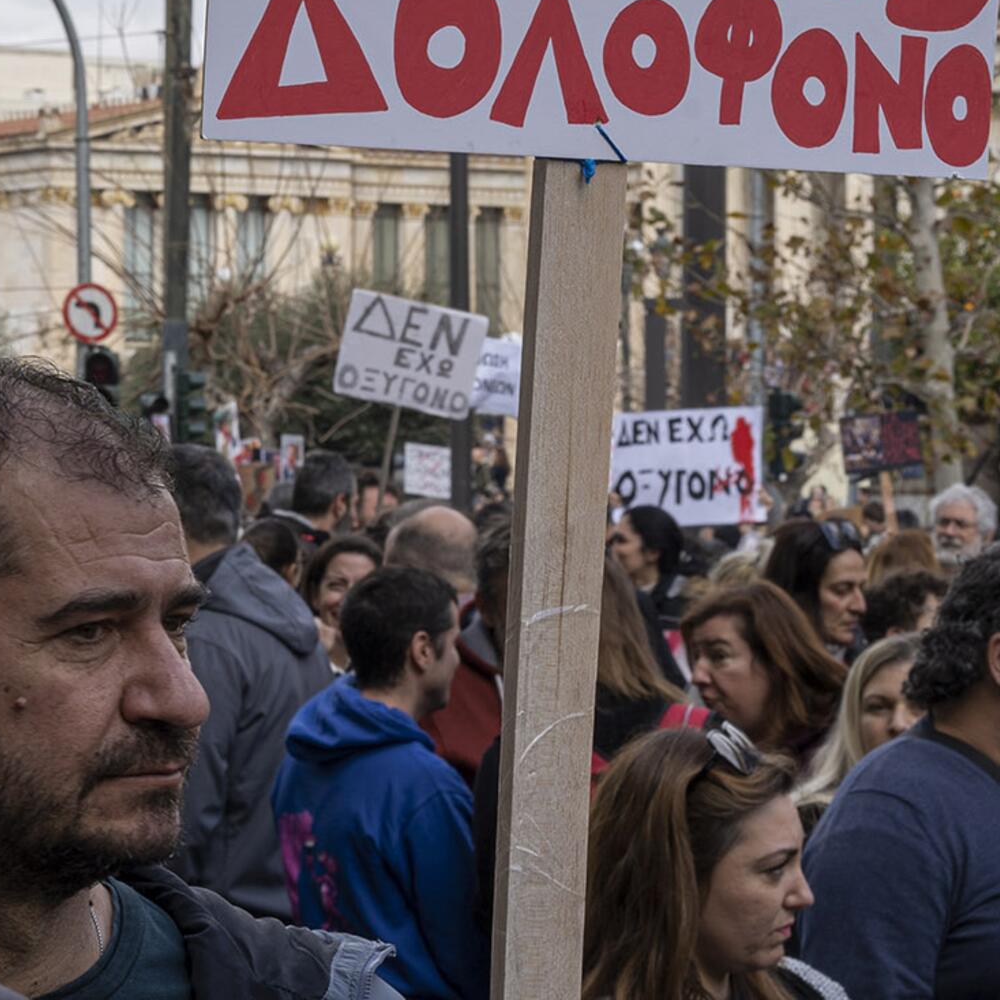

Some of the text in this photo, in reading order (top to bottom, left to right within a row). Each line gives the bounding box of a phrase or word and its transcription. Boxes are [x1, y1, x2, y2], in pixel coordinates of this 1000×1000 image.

[352, 296, 472, 357] ΔΕΝ
[394, 347, 455, 378] ΕΧΩ
[338, 364, 469, 413] ΟΞΥΓΟΝΟ
[617, 413, 730, 447] ΔΕΝ ΕΧΩ
